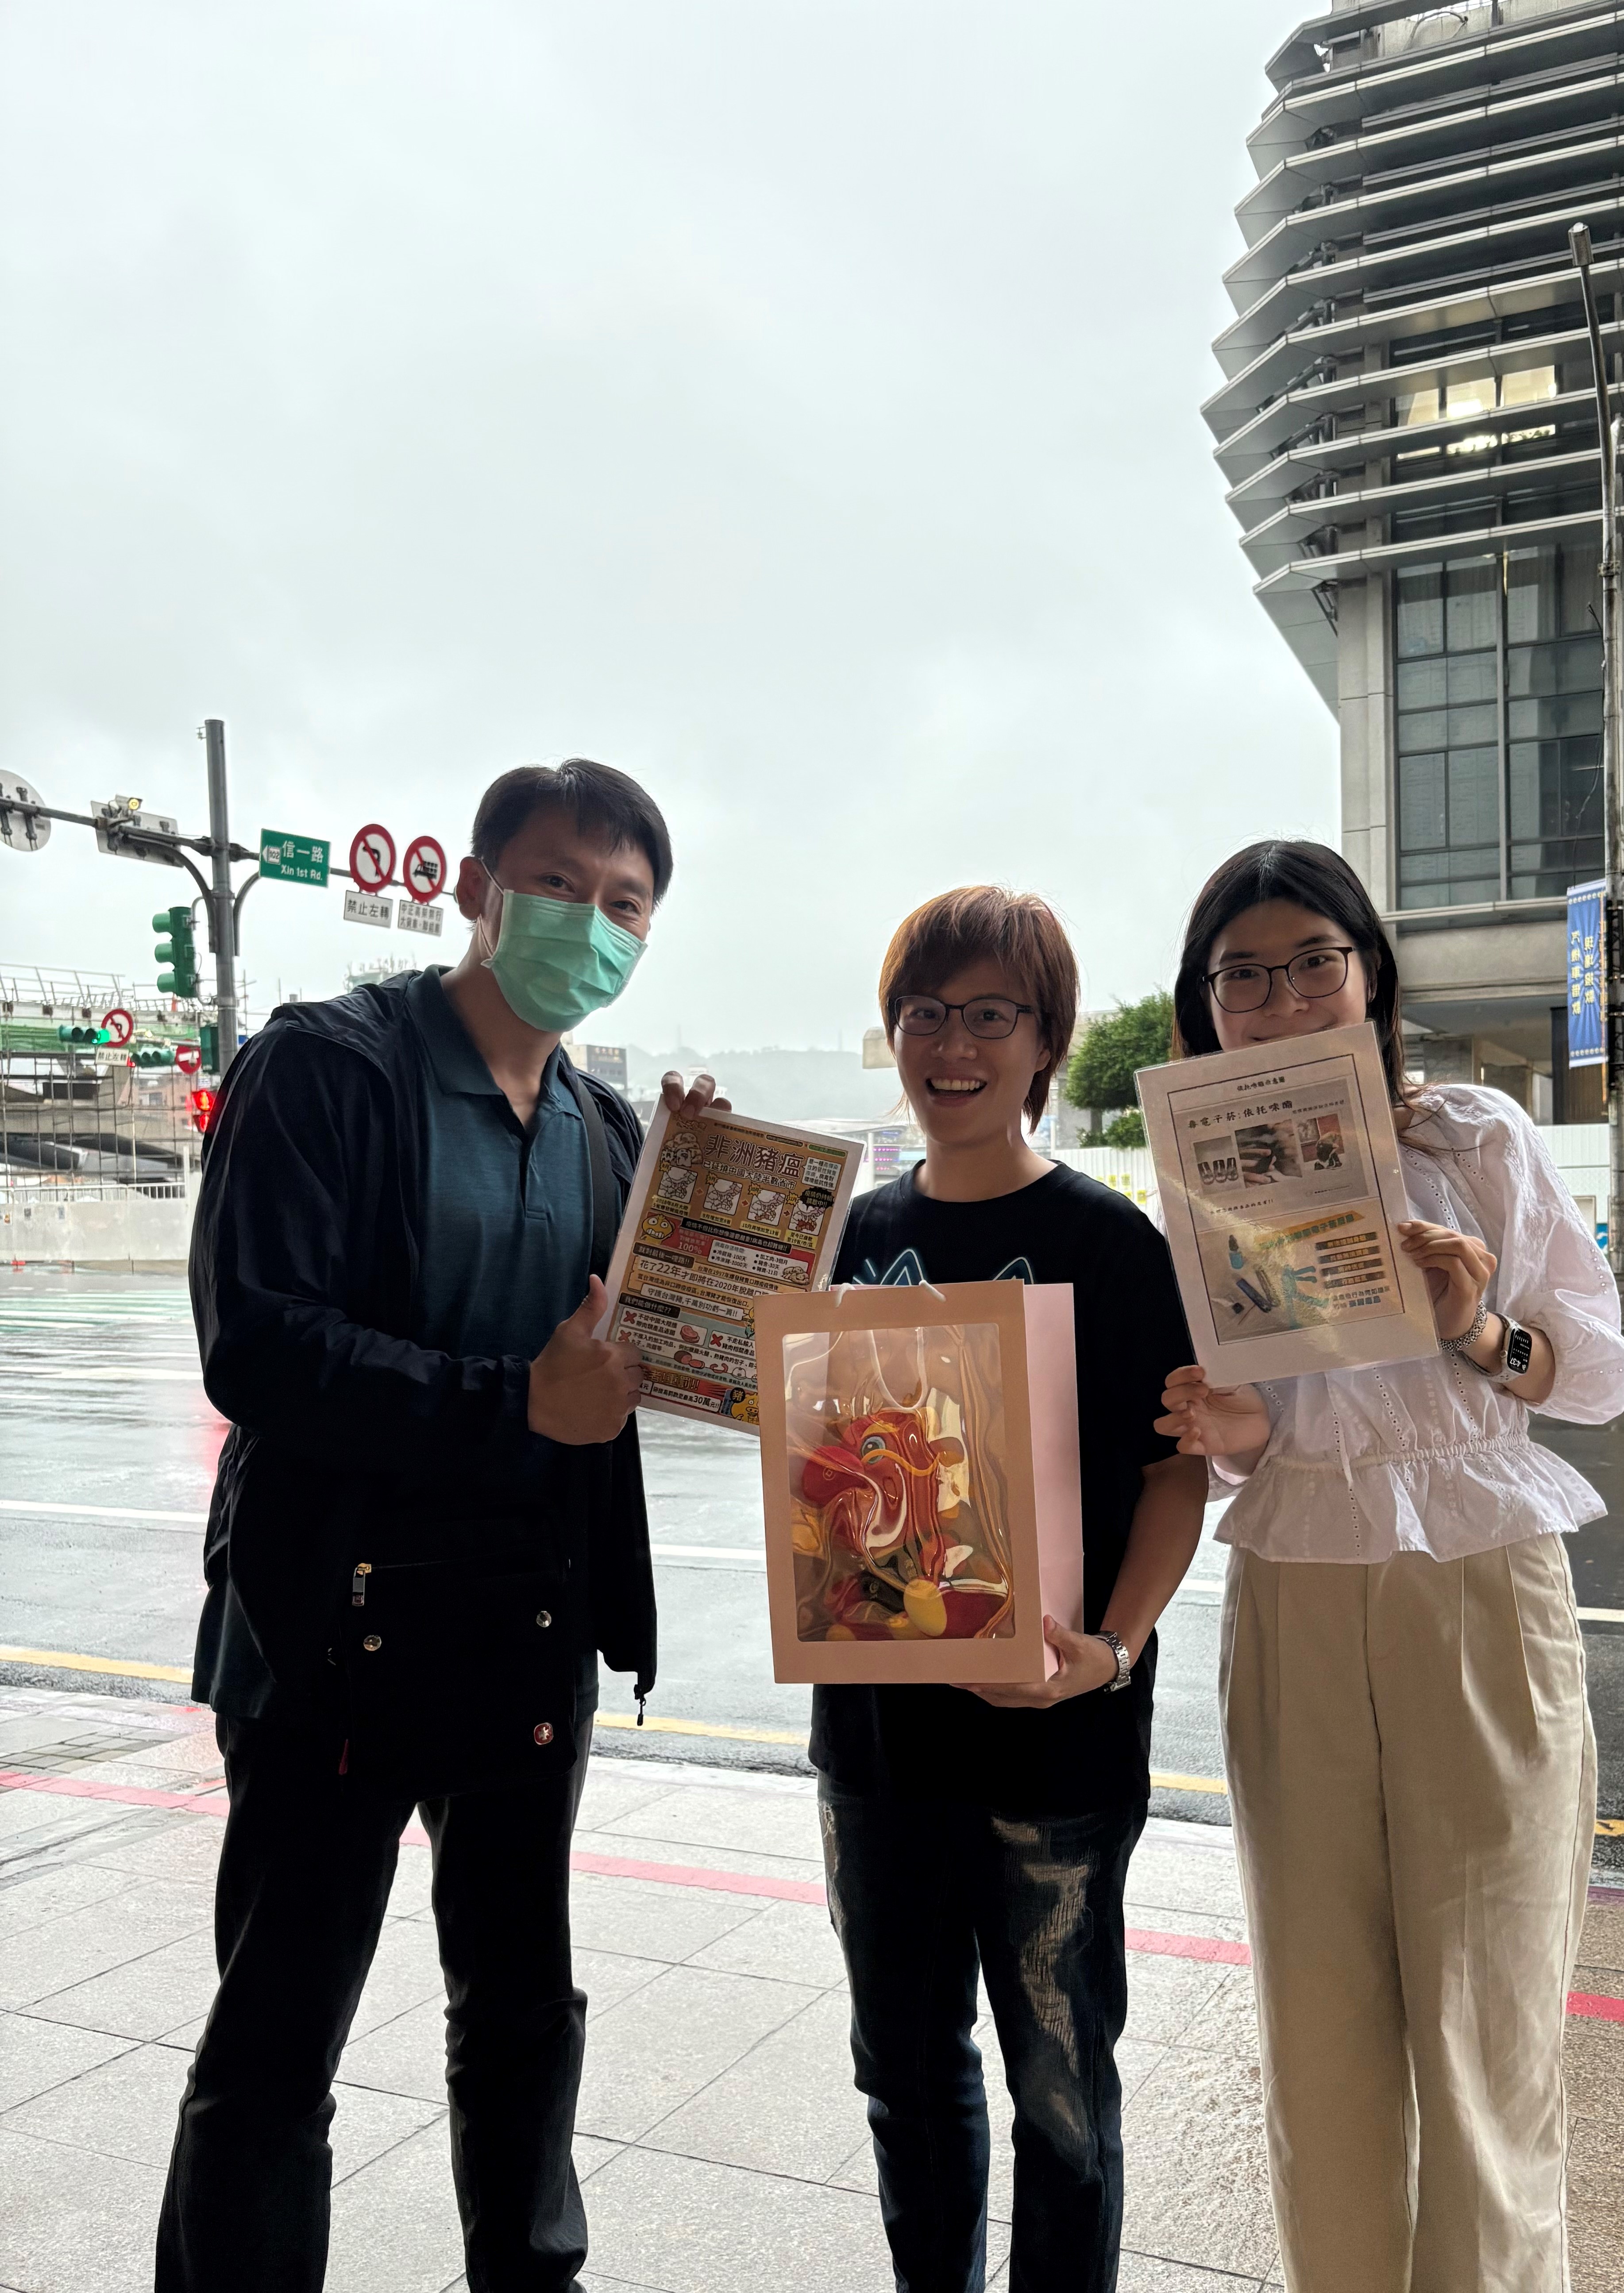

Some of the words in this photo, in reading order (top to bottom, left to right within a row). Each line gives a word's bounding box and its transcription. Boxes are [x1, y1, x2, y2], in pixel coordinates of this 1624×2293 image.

[269, 850, 280, 859] 102
[282, 840, 324, 863] 信一路
[281, 864, 294, 876] Xin
[297, 866, 308, 878] 1st
[310, 870, 323, 880] Rd.
[347, 899, 389, 920] 禁止左轉
[703, 1132, 806, 1179] 非洲豬瘟
[702, 1160, 797, 1190] 已延燒中國大陸半數省市
[677, 1241, 703, 1254] 100%
[639, 1258, 770, 1300] 花了22年才即將在2020年脫離口
[731, 1389, 744, 1401] 豬
